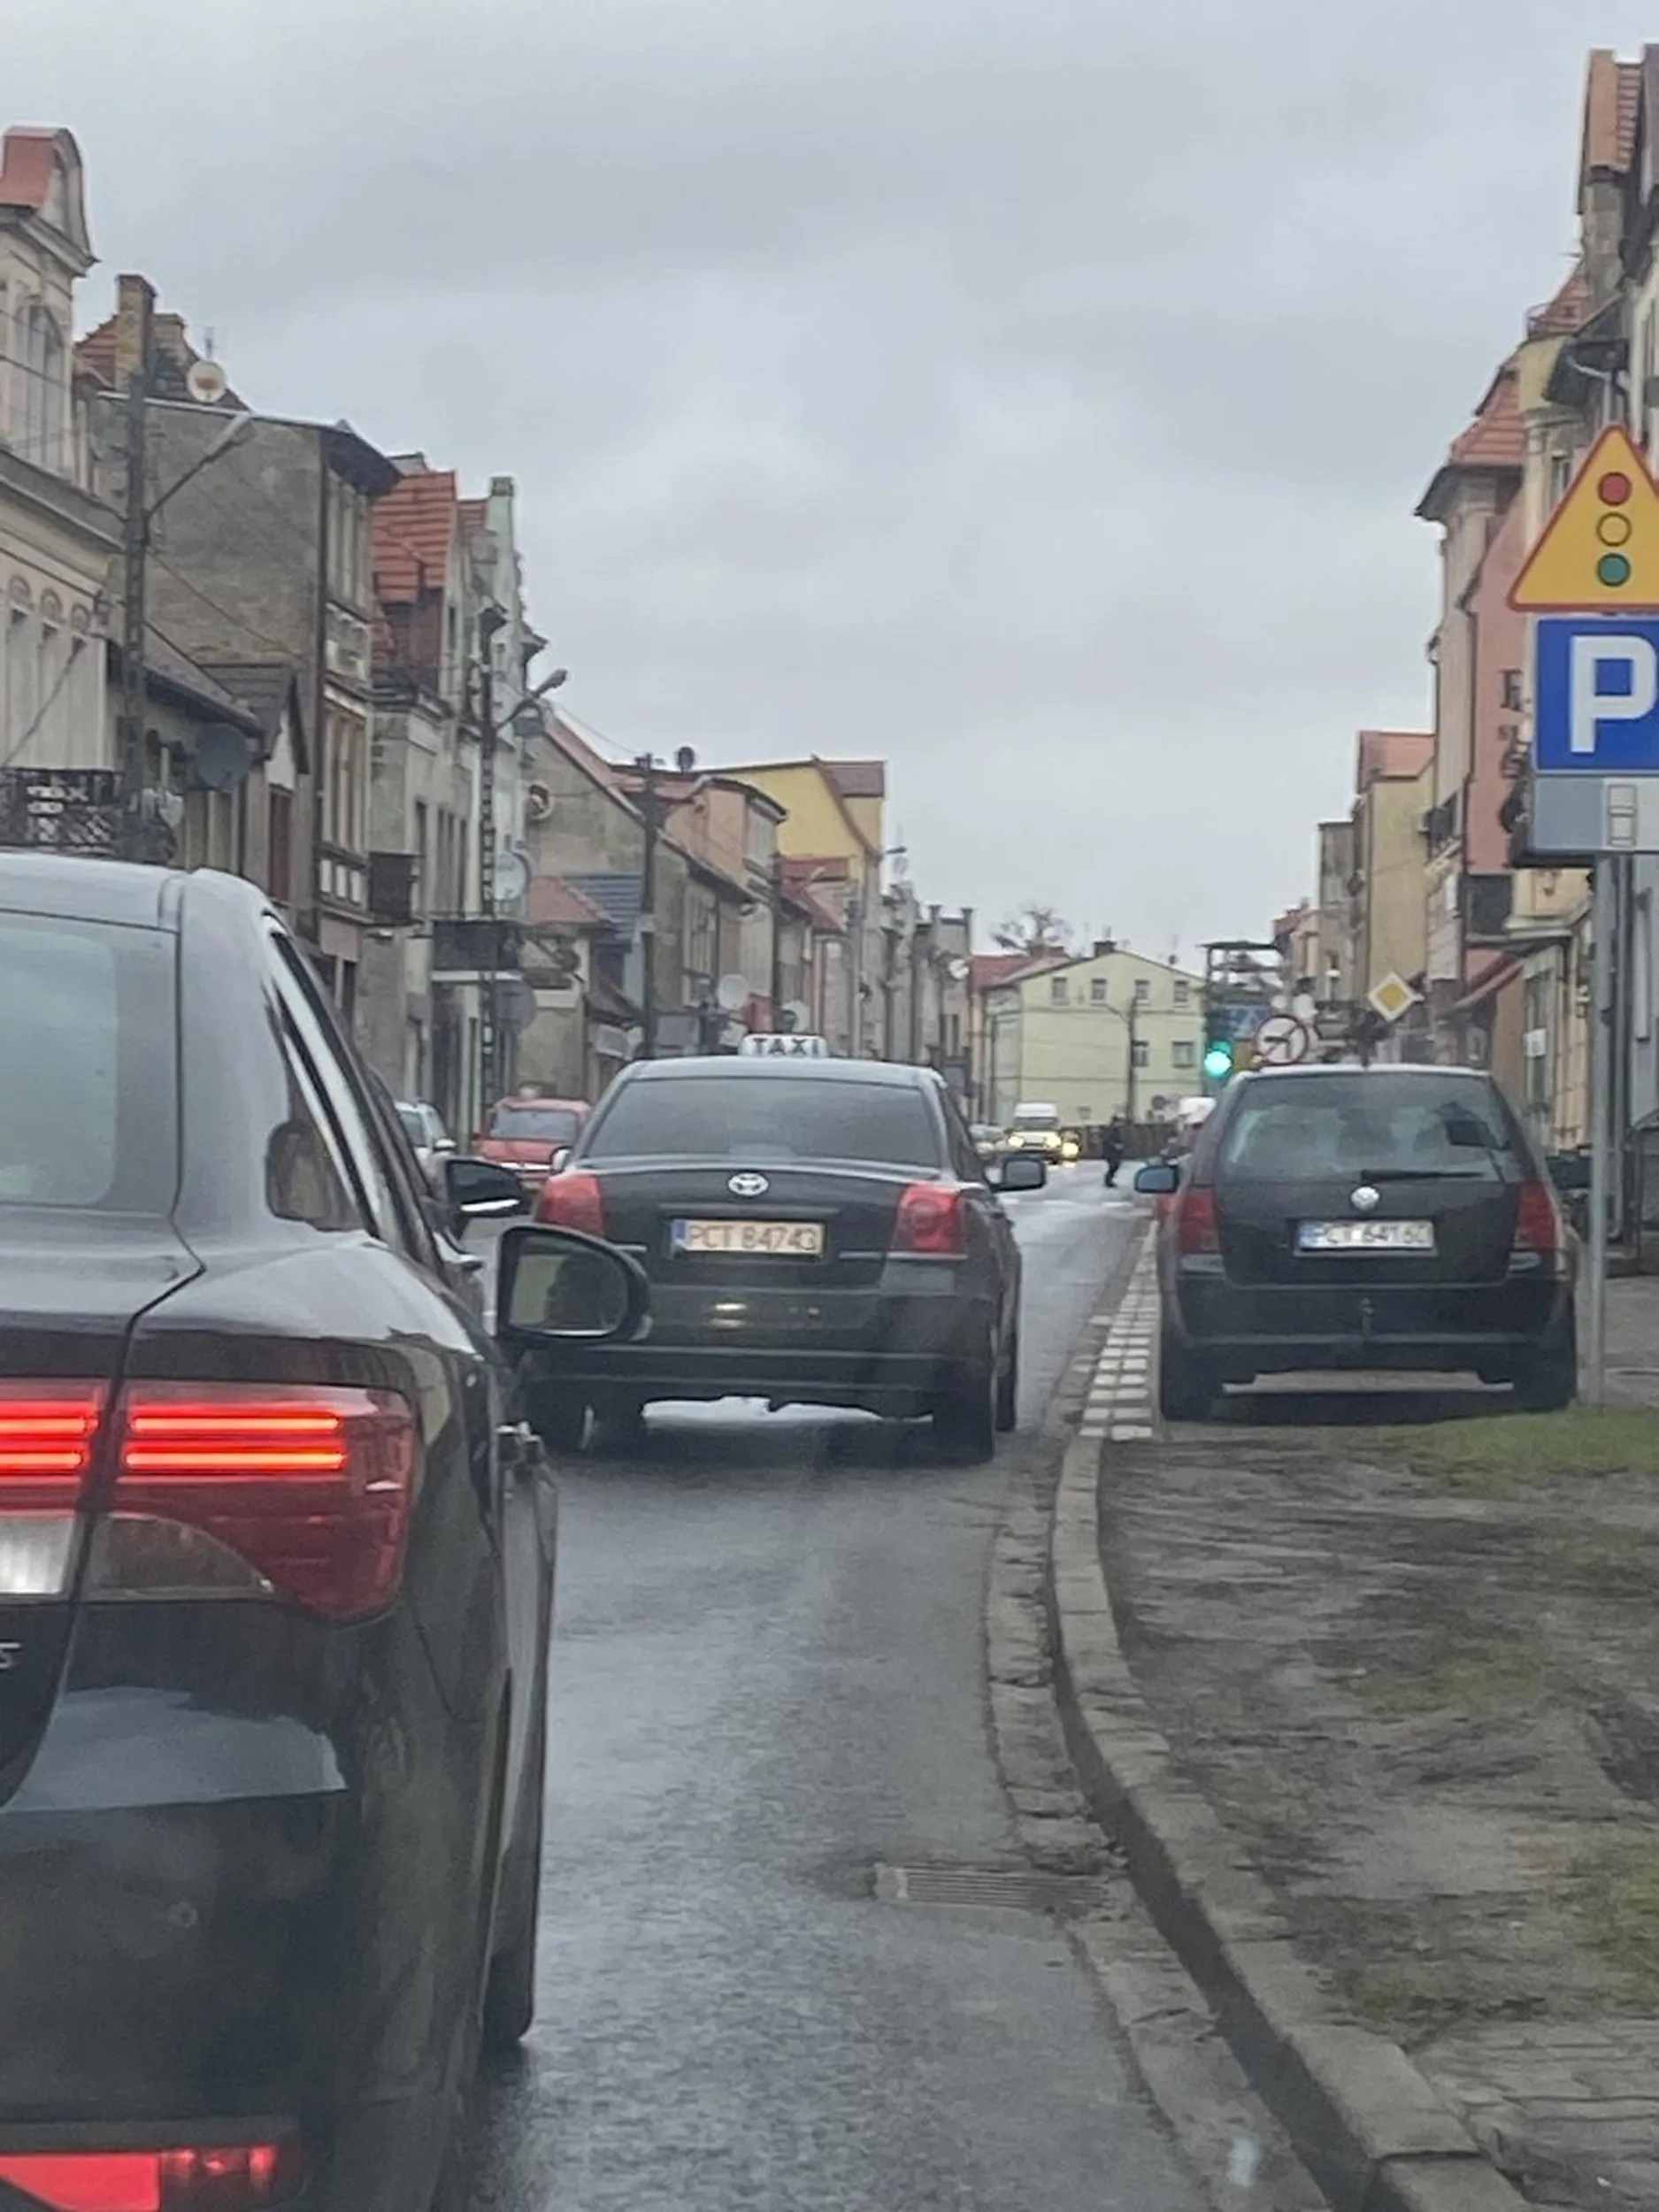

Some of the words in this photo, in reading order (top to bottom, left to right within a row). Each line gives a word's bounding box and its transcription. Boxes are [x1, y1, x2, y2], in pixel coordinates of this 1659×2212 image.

[1570, 635, 1657, 752] P
[753, 1037, 819, 1058] TAXI
[689, 1224, 734, 1249] PCT
